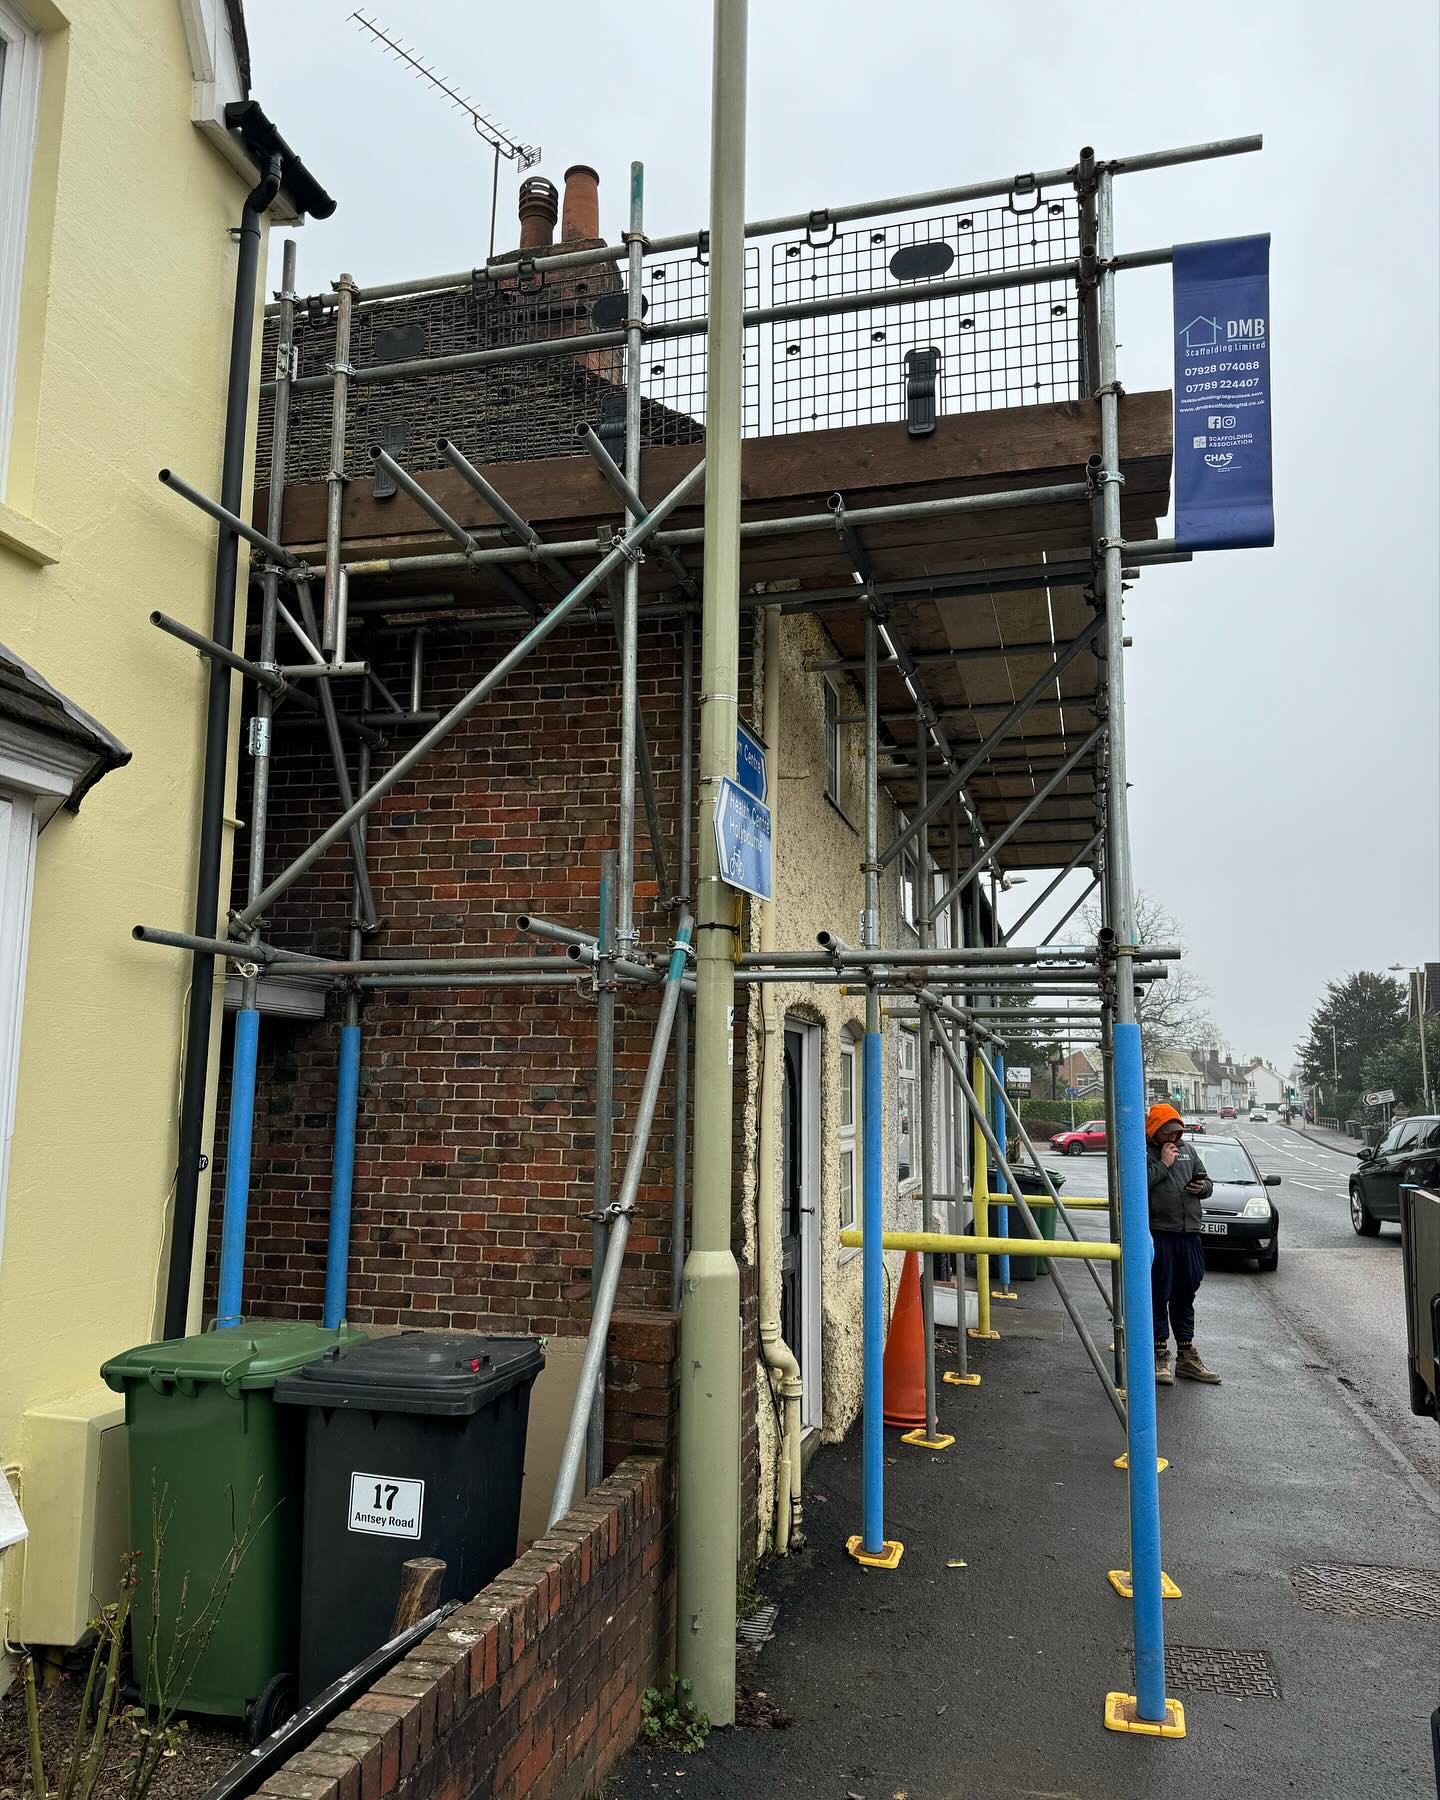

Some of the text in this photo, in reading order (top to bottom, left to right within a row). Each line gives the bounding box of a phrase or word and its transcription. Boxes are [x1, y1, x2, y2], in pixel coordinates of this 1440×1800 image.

[1227, 319, 1265, 338] DMB
[1185, 341, 1266, 357] Scaffolding Limited
[1185, 361, 1260, 376] 07928 074088
[1186, 378, 1260, 393] 07789 224407
[1209, 433, 1253, 441] SCAFFOLDING
[1209, 439, 1253, 447] ASSOCIATION
[1204, 453, 1233, 462] CHAS
[744, 744, 760, 774] Centre
[730, 790, 770, 835] Health Centre
[730, 815, 762, 853] Holybourne
[1208, 1224, 1226, 1233] EUR
[373, 1483, 399, 1511] 17
[355, 1512, 414, 1528] Antsey Road
